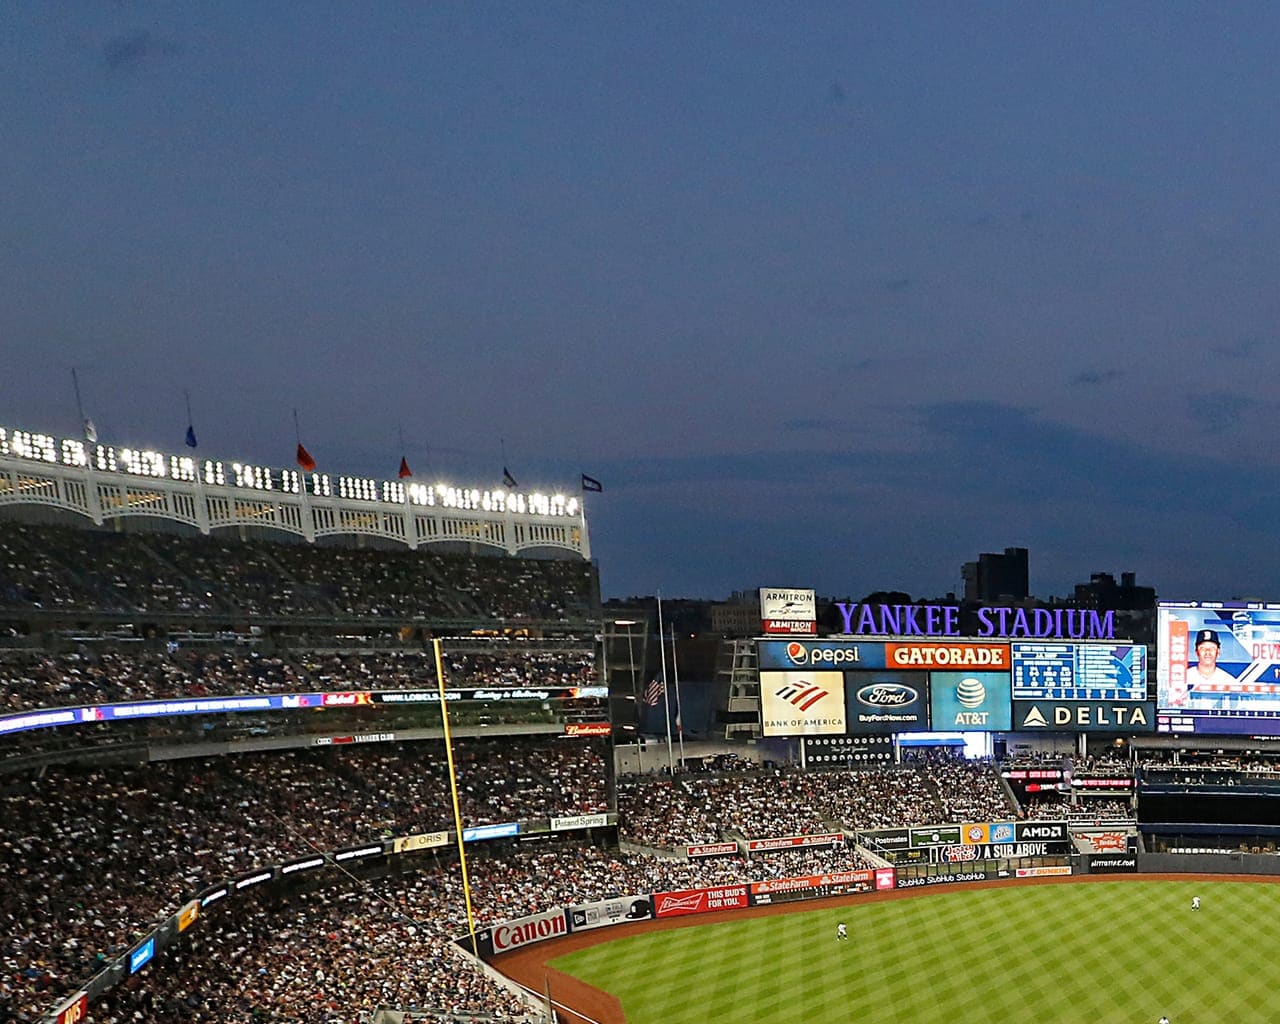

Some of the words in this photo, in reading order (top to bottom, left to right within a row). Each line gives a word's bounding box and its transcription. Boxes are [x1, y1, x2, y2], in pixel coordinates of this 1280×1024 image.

[766, 593, 812, 601] ARMITRON
[769, 621, 812, 629] ARMITRON
[834, 602, 960, 637] YANKEE
[977, 606, 1116, 639] STADIUM
[811, 646, 860, 664] pepsi
[894, 648, 1003, 665] GATORADE
[869, 688, 905, 704] Ford
[859, 713, 917, 722] BuyFordNow.com
[955, 712, 988, 725] AT&T
[1055, 706, 1147, 725] DELTA
[580, 817, 605, 828] Spring
[1022, 827, 1051, 838] AMD
[418, 834, 442, 845] ORIS
[875, 836, 907, 844] Postmates
[1017, 843, 1047, 855] ABOVE
[927, 875, 955, 884] StubHub
[957, 873, 985, 881] StubHub
[898, 879, 925, 888] StubHub
[708, 890, 724, 900] THIS
[725, 888, 746, 898] BUD'S
[708, 899, 721, 908] FOR
[722, 897, 740, 907] YOU.
[494, 914, 566, 949] Canon
